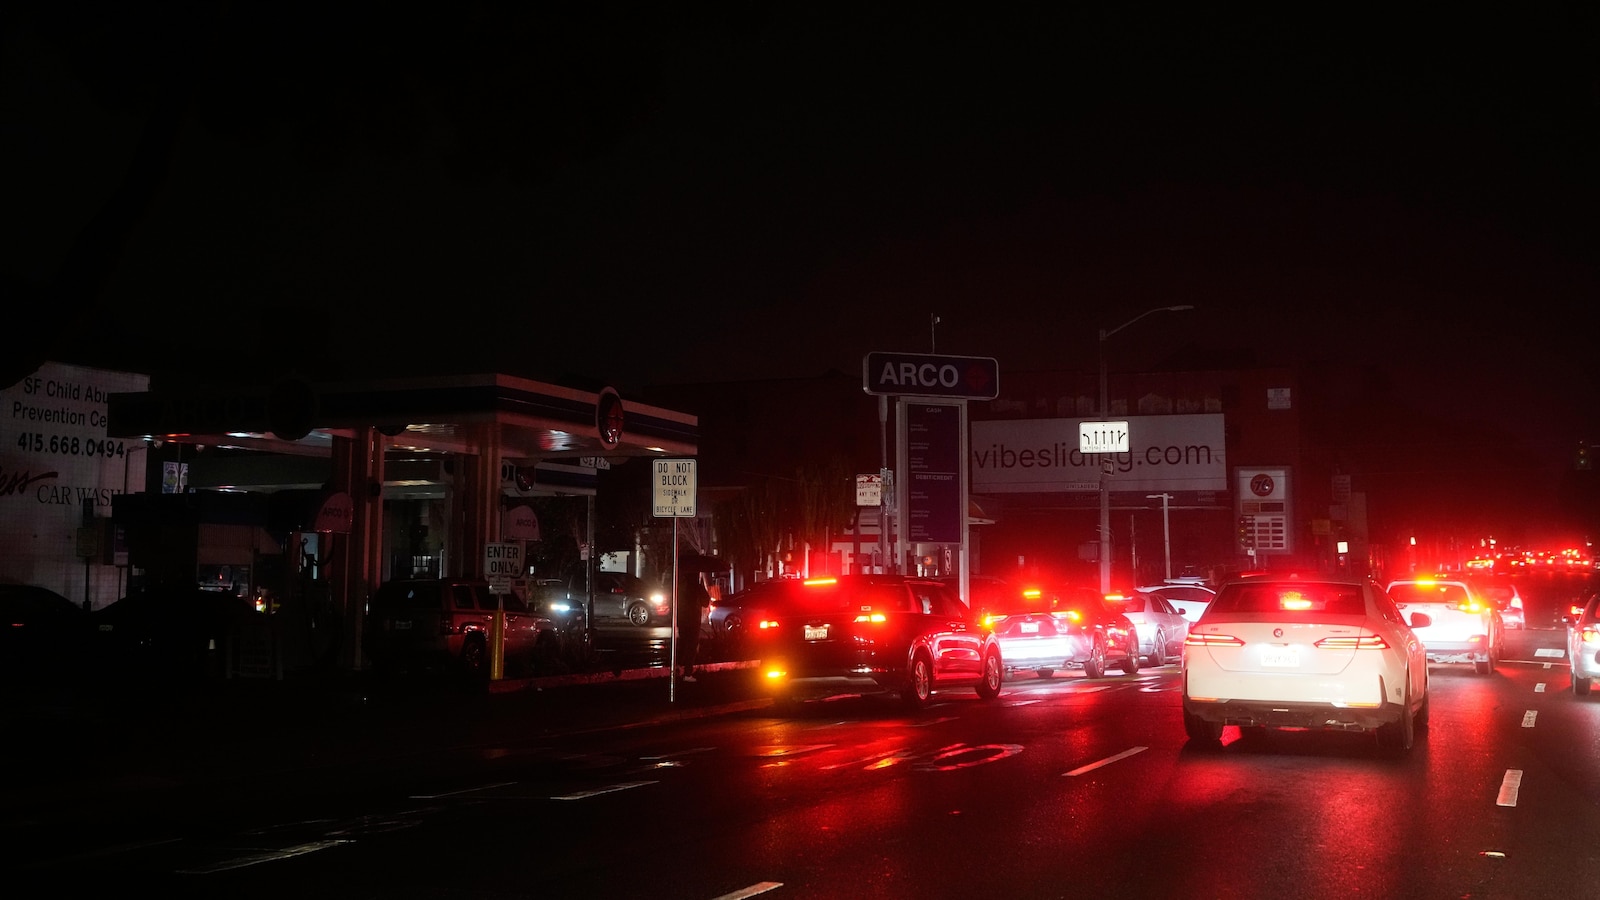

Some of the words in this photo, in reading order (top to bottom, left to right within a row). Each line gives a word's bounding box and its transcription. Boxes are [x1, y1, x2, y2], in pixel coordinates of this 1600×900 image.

[880, 362, 959, 388] ARCO
[24, 377, 42, 395] SF
[46, 380, 80, 401] Child
[85, 385, 108, 404] Abu
[13, 401, 85, 426] Prevention
[90, 410, 107, 428] Ce
[18, 432, 124, 459] 415.668.0494
[658, 463, 668, 473] DO
[676, 463, 691, 473] NOT
[662, 475, 688, 486] BLOCK
[1254, 479, 1270, 492] 76
[37, 485, 71, 505] CAR
[663, 489, 687, 497] SIDEWALK
[515, 519, 532, 527] ARCO
[487, 546, 519, 559] ENTER
[490, 561, 514, 573] ONLY
